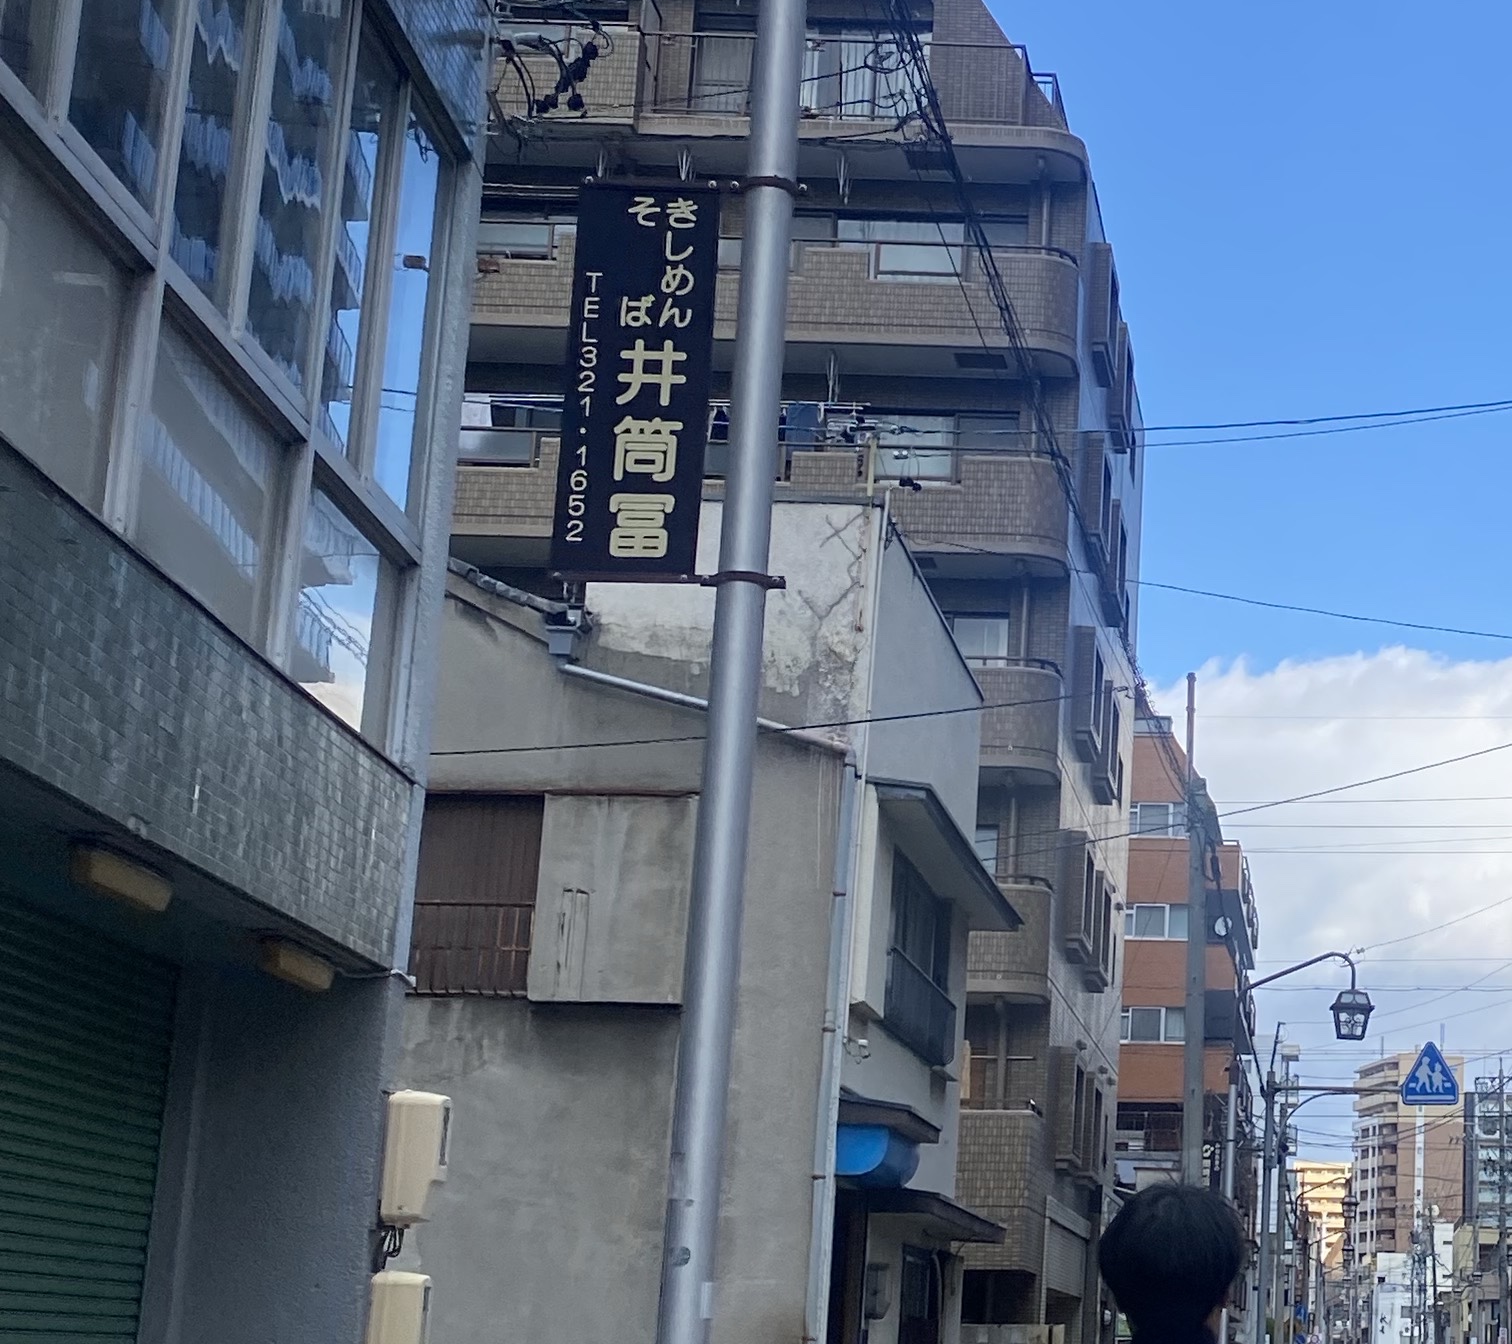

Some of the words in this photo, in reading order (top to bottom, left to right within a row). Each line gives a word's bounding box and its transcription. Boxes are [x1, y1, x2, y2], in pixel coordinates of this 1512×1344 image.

[620, 196, 661, 327] そば
[658, 197, 699, 329] きしめん
